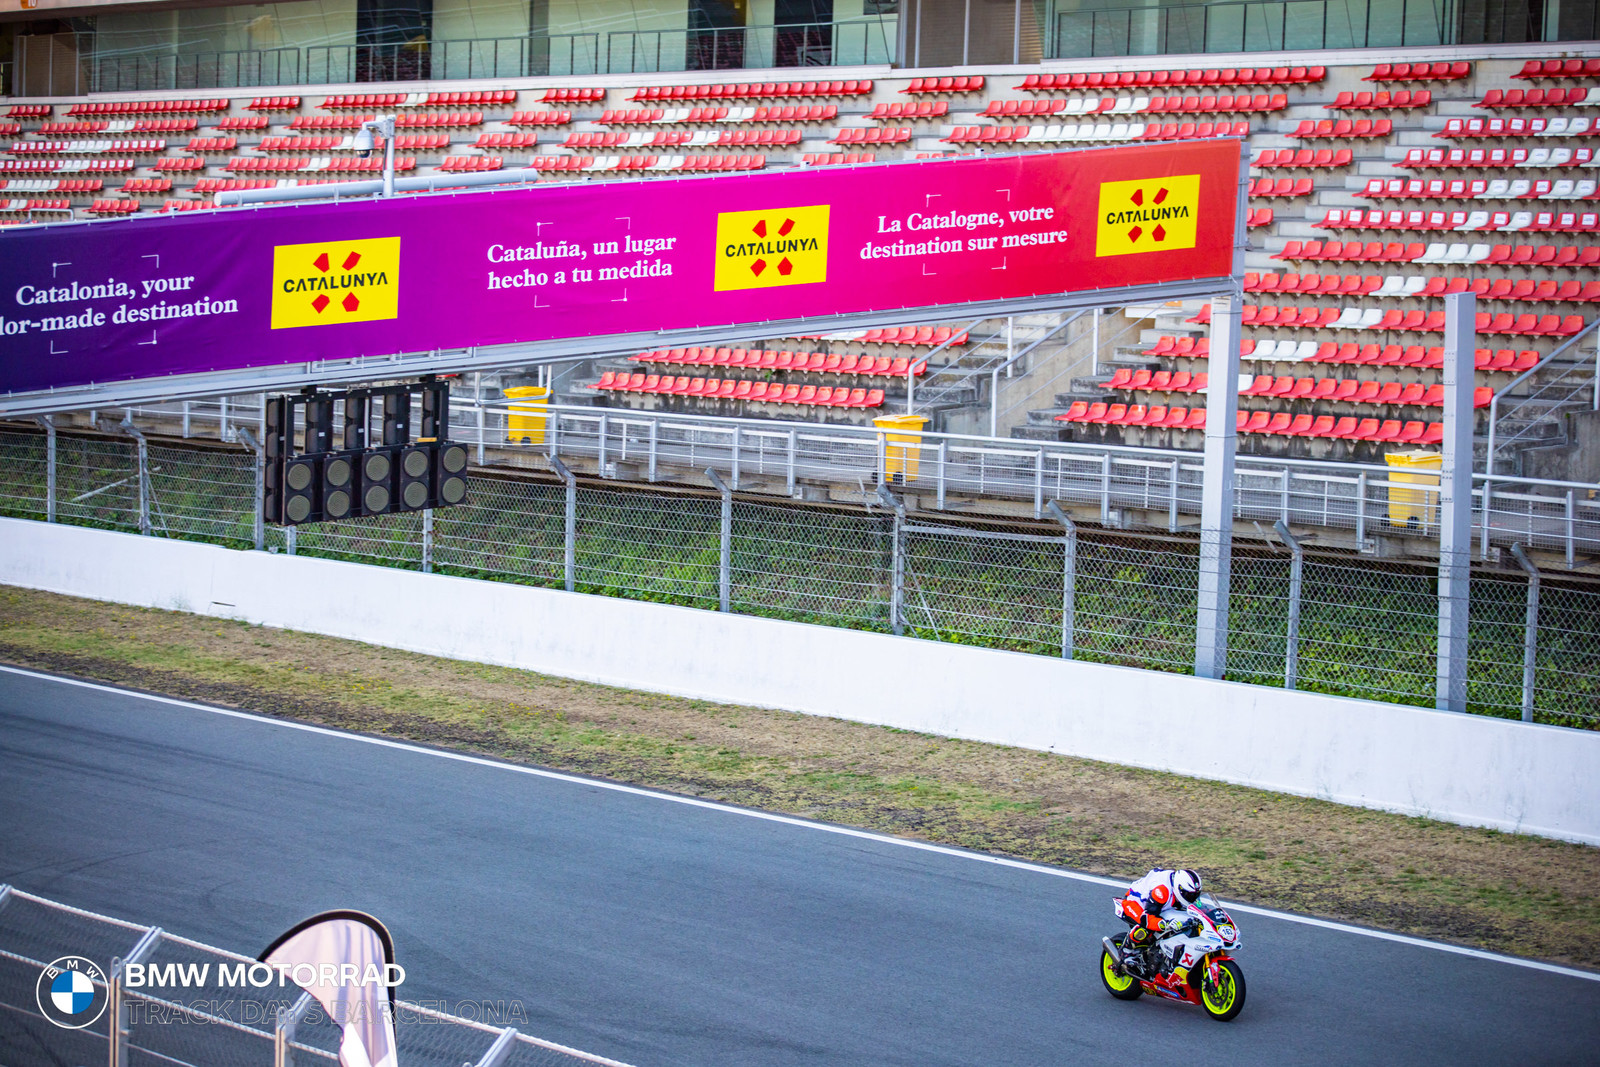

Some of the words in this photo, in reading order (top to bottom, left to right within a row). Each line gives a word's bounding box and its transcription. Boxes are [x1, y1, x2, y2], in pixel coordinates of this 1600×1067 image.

[877, 215, 902, 234] La
[906, 210, 1005, 231] Catalogne,
[1008, 206, 1054, 223] votre
[1106, 205, 1189, 225] CATALUNYA
[487, 240, 588, 263] Cataluña,
[592, 241, 619, 255] un
[623, 234, 677, 256] lugar
[725, 237, 819, 258] CATALUNYA
[859, 236, 963, 260] destination
[967, 236, 998, 251] sur
[1001, 230, 1068, 248] mesure
[283, 271, 388, 293] CATALUNYA
[487, 268, 549, 290] hecho
[553, 271, 567, 285] a
[571, 267, 593, 283] tu
[598, 258, 673, 281] medida
[16, 277, 136, 306] Catalonia,
[141, 275, 195, 299] your
[112, 296, 239, 325] destination
